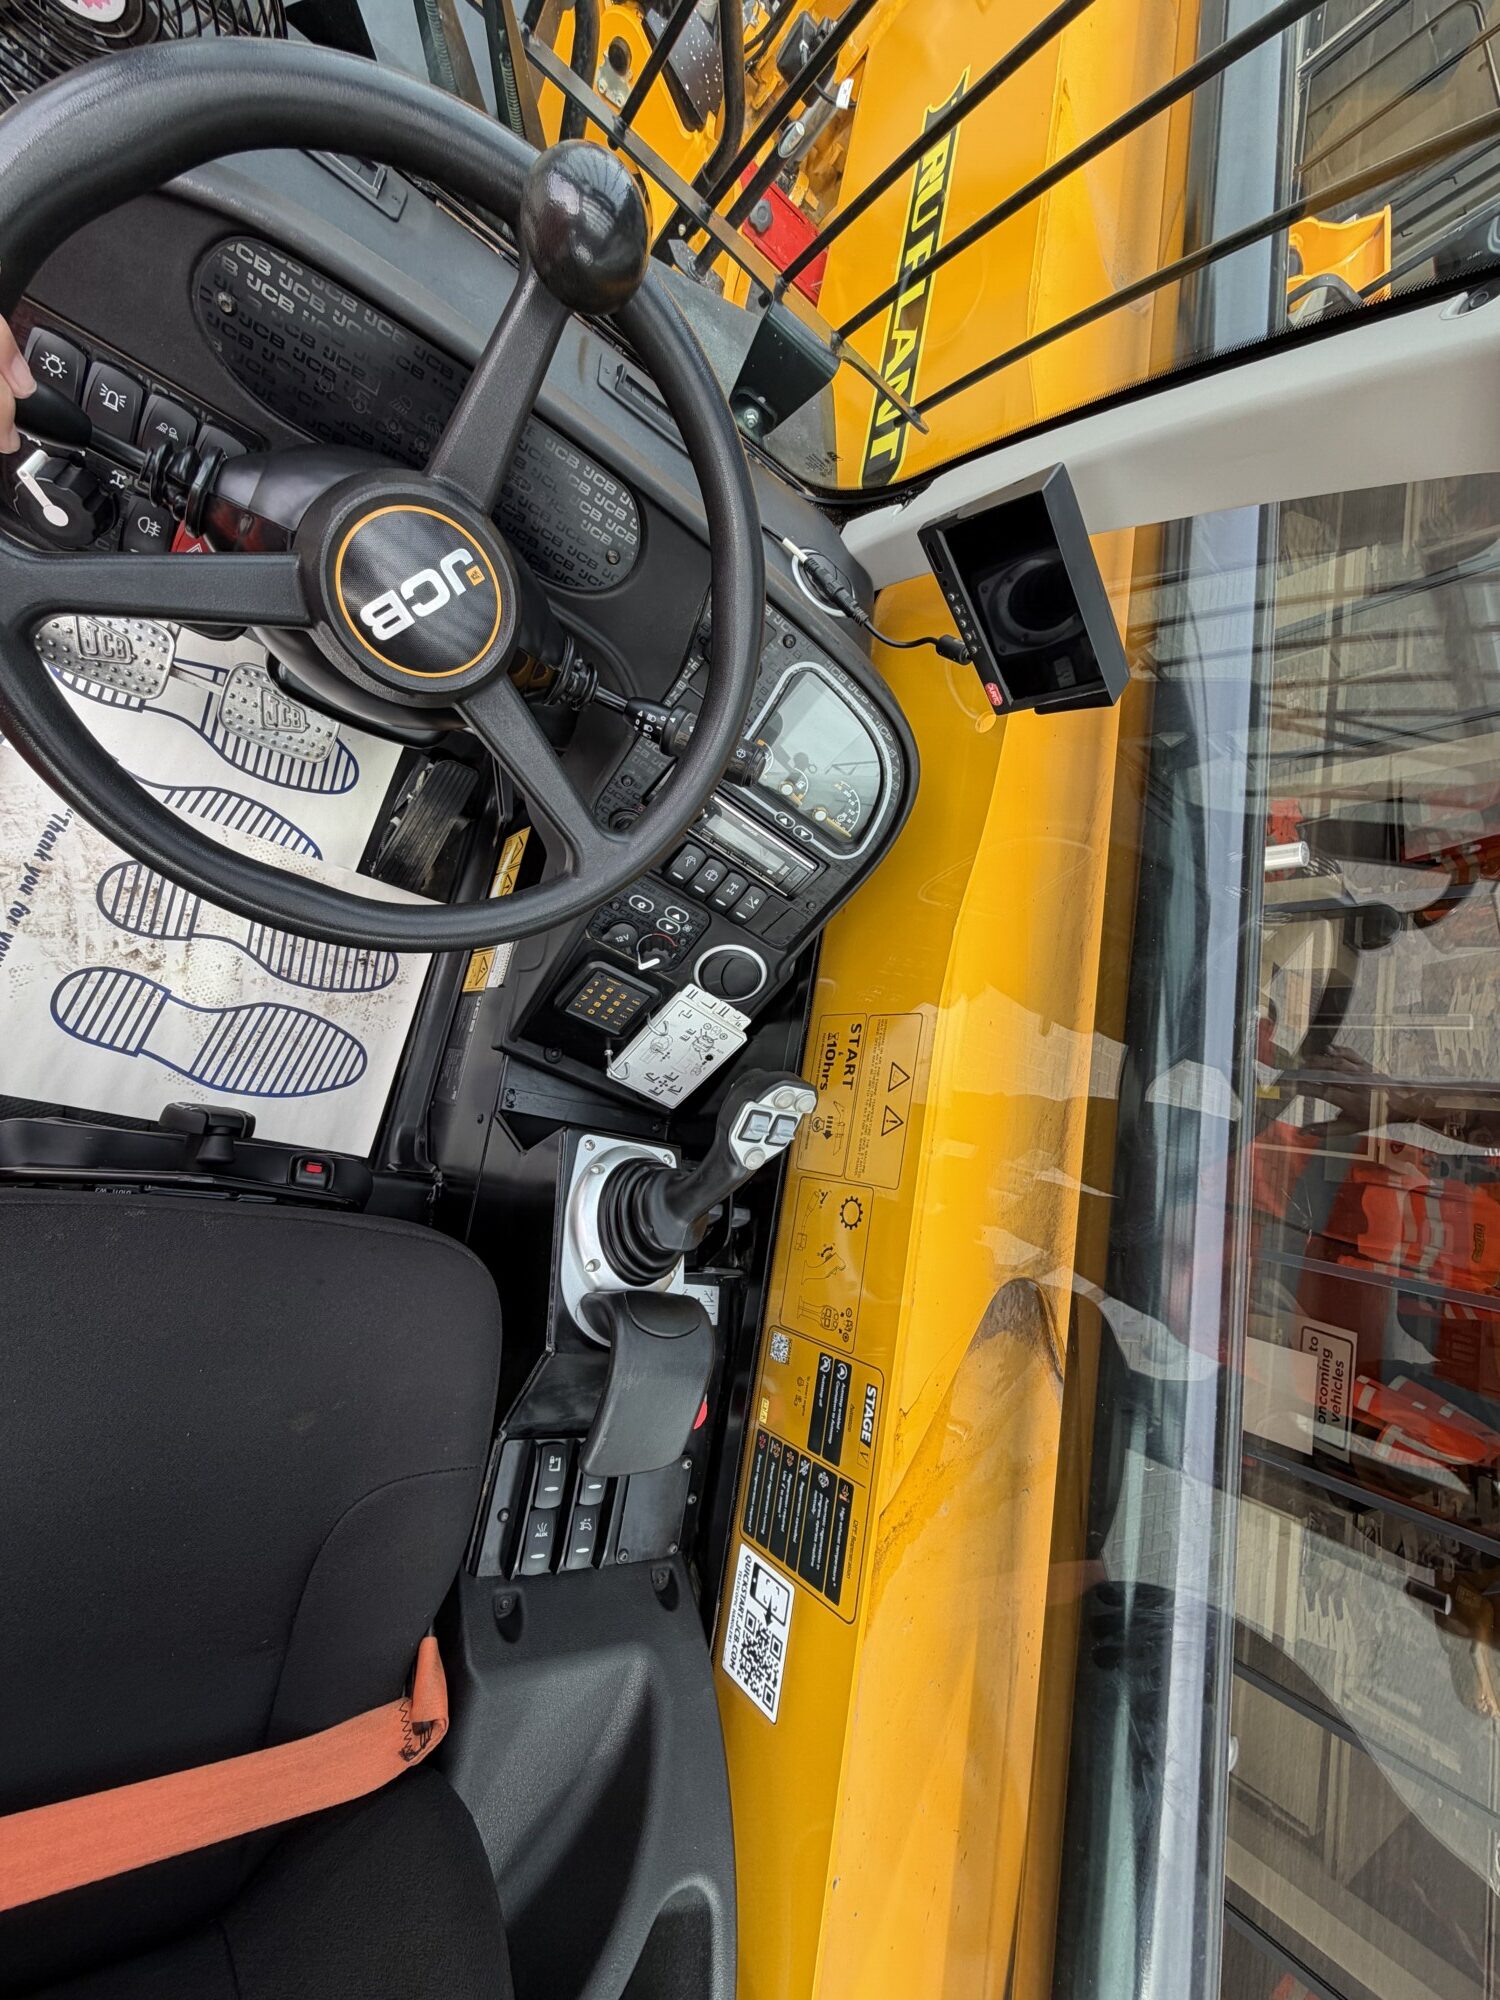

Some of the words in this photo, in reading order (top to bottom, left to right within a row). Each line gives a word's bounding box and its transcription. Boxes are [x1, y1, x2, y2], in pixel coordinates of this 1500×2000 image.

[245, 273, 297, 314] JCB
[277, 271, 329, 314] JCB
[582, 464, 617, 494] JCB
[593, 492, 627, 520] JCB
[580, 518, 613, 546] JCB
[604, 519, 638, 545] JCB
[358, 548, 485, 640] JCB
[86, 621, 126, 658] JCB
[266, 695, 300, 728] JCB
[17, 863, 40, 896] you
[6, 900, 30, 926] for
[615, 933, 628, 942] 12V
[819, 1040, 837, 1091] 10hrs
[841, 1023, 861, 1090] START
[1308, 1335, 1319, 1350] to
[818, 1374, 826, 1398] Autostop
[1317, 1347, 1333, 1424] oncoming
[1331, 1359, 1344, 1422] vehicles
[860, 1385, 876, 1442] STAGE
[859, 1451, 868, 1462] V
[749, 1473, 759, 1507] regeneration
[762, 1481, 772, 1515] regeneration
[782, 1473, 793, 1508] Regeneration
[794, 1480, 805, 1517] Regeneration
[809, 1489, 819, 1515] normally
[746, 1506, 754, 1529] required
[759, 1514, 767, 1534] running
[779, 1507, 787, 1532] required
[821, 1497, 830, 1526] Automatic
[812, 1519, 820, 1542] operate
[815, 1526, 825, 1564] regeneration
[829, 1544, 840, 1581] temperature
[845, 1535, 856, 1579] Regeneration
[732, 1569, 742, 1608] TELESCOPIC
[726, 1607, 736, 1643] HANDLERS
[728, 1554, 752, 1670] QUICKSTART.JCB.COM
